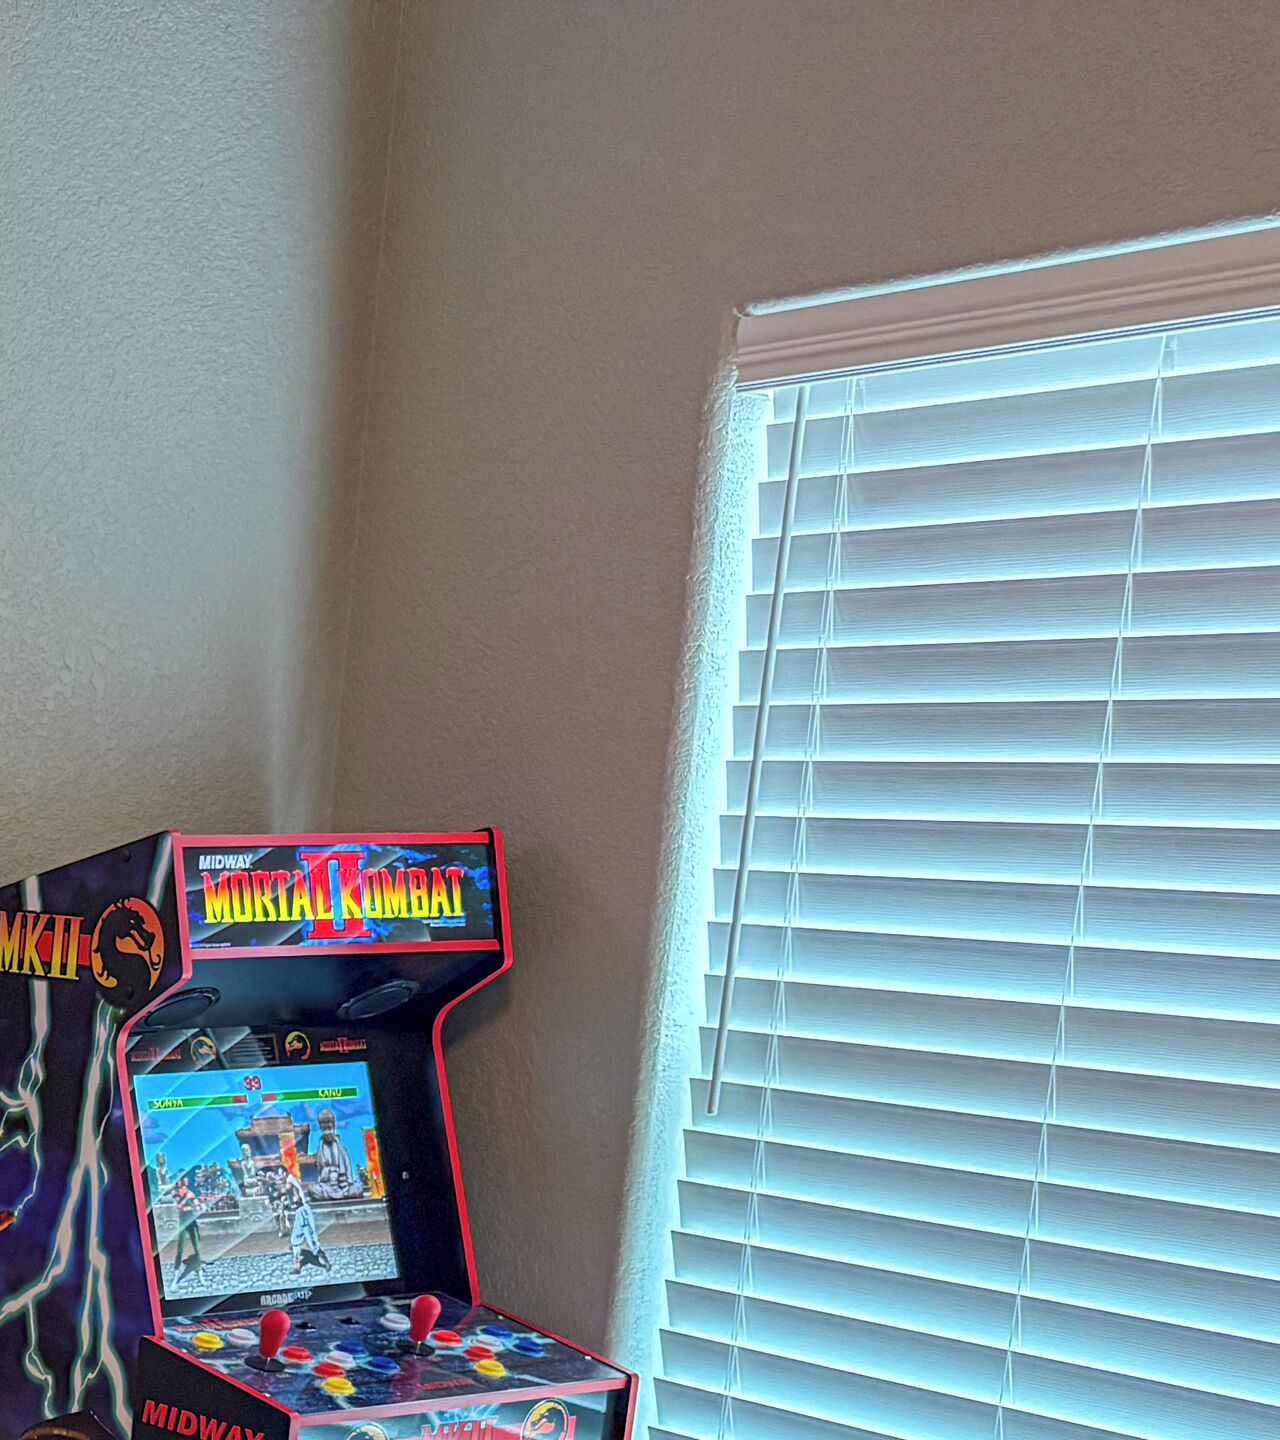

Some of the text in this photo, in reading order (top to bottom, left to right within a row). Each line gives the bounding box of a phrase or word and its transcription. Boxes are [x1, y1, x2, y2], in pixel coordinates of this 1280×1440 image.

[198, 854, 253, 870] MIDWAY
[200, 866, 335, 924] MORTAL
[337, 866, 465, 920] KOMBAT
